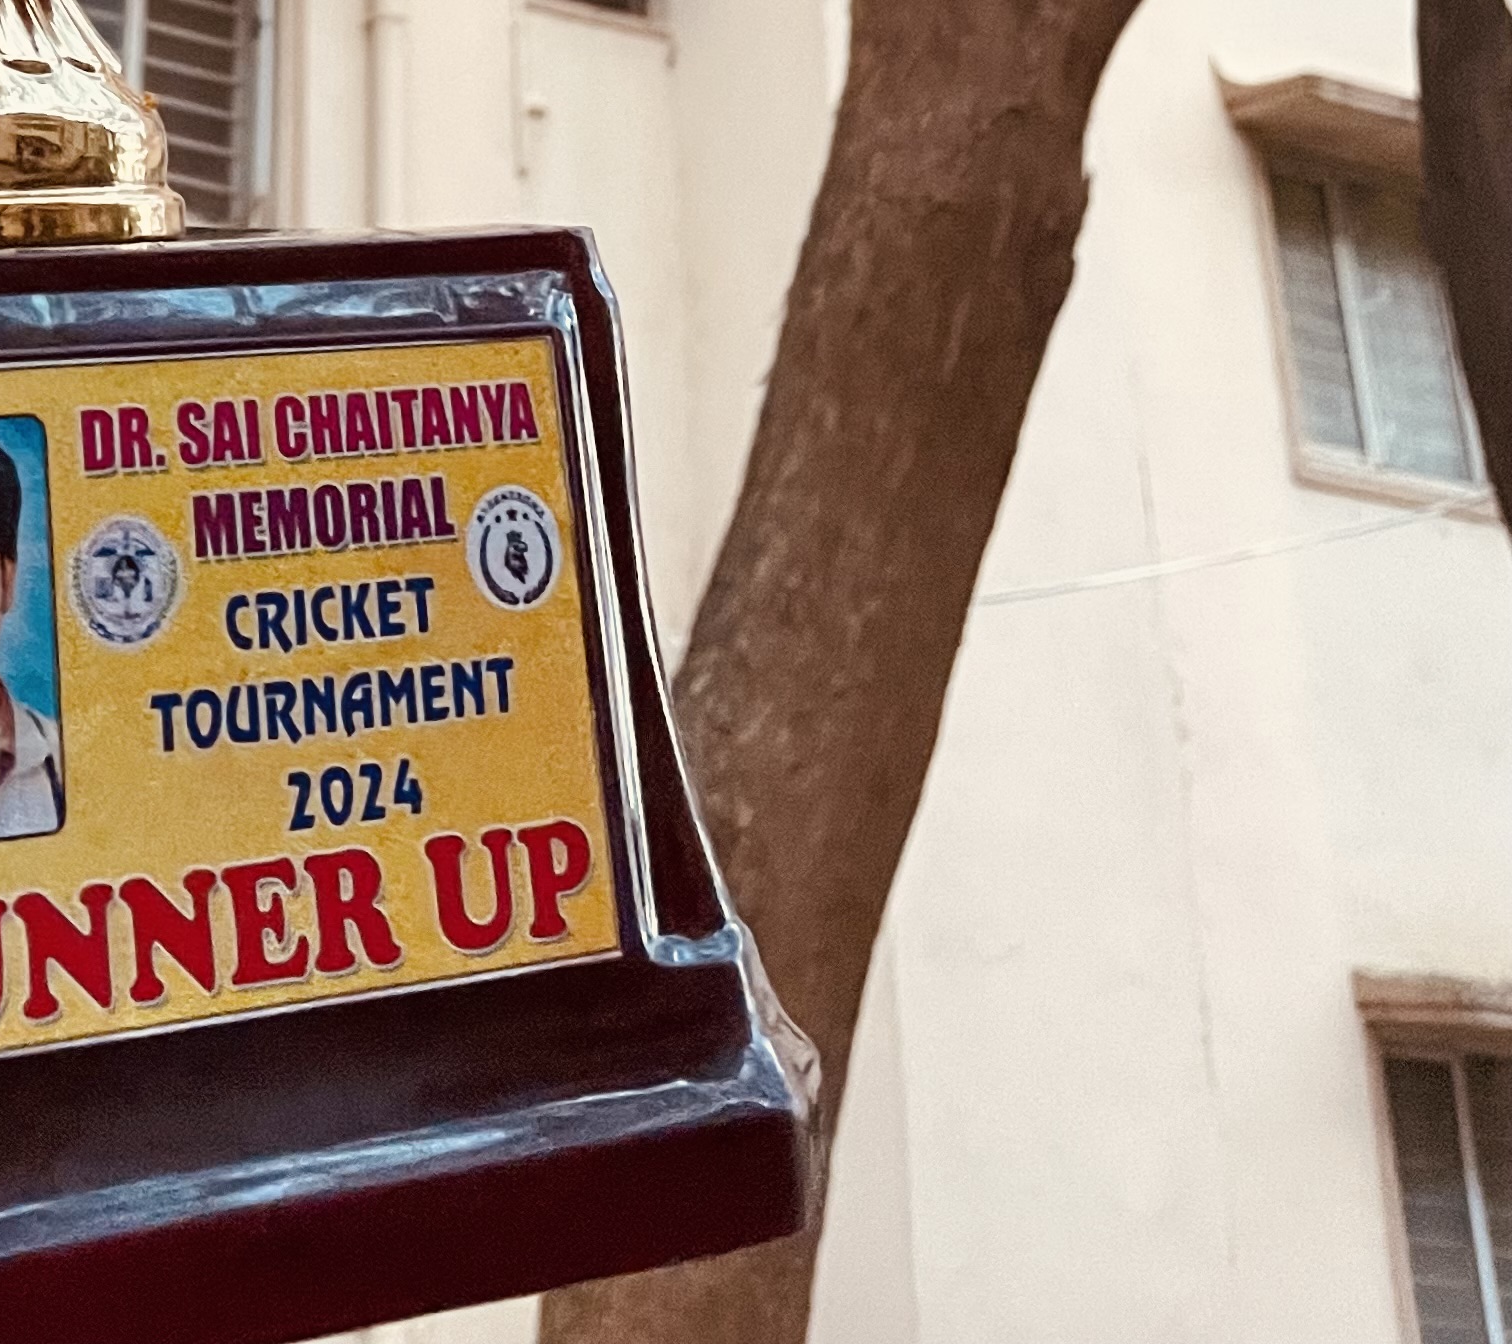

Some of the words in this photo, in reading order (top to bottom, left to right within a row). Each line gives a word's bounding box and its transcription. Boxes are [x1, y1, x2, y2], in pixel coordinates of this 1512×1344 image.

[82, 408, 167, 471] DR.
[178, 399, 262, 465] SAI
[275, 382, 538, 458] CHAITANYA
[193, 477, 455, 559] MEMORIAL
[226, 577, 434, 653] CRICKET
[150, 657, 514, 752] TOURNAMENT
[289, 758, 423, 832] 2024
[425, 819, 591, 953] UP
